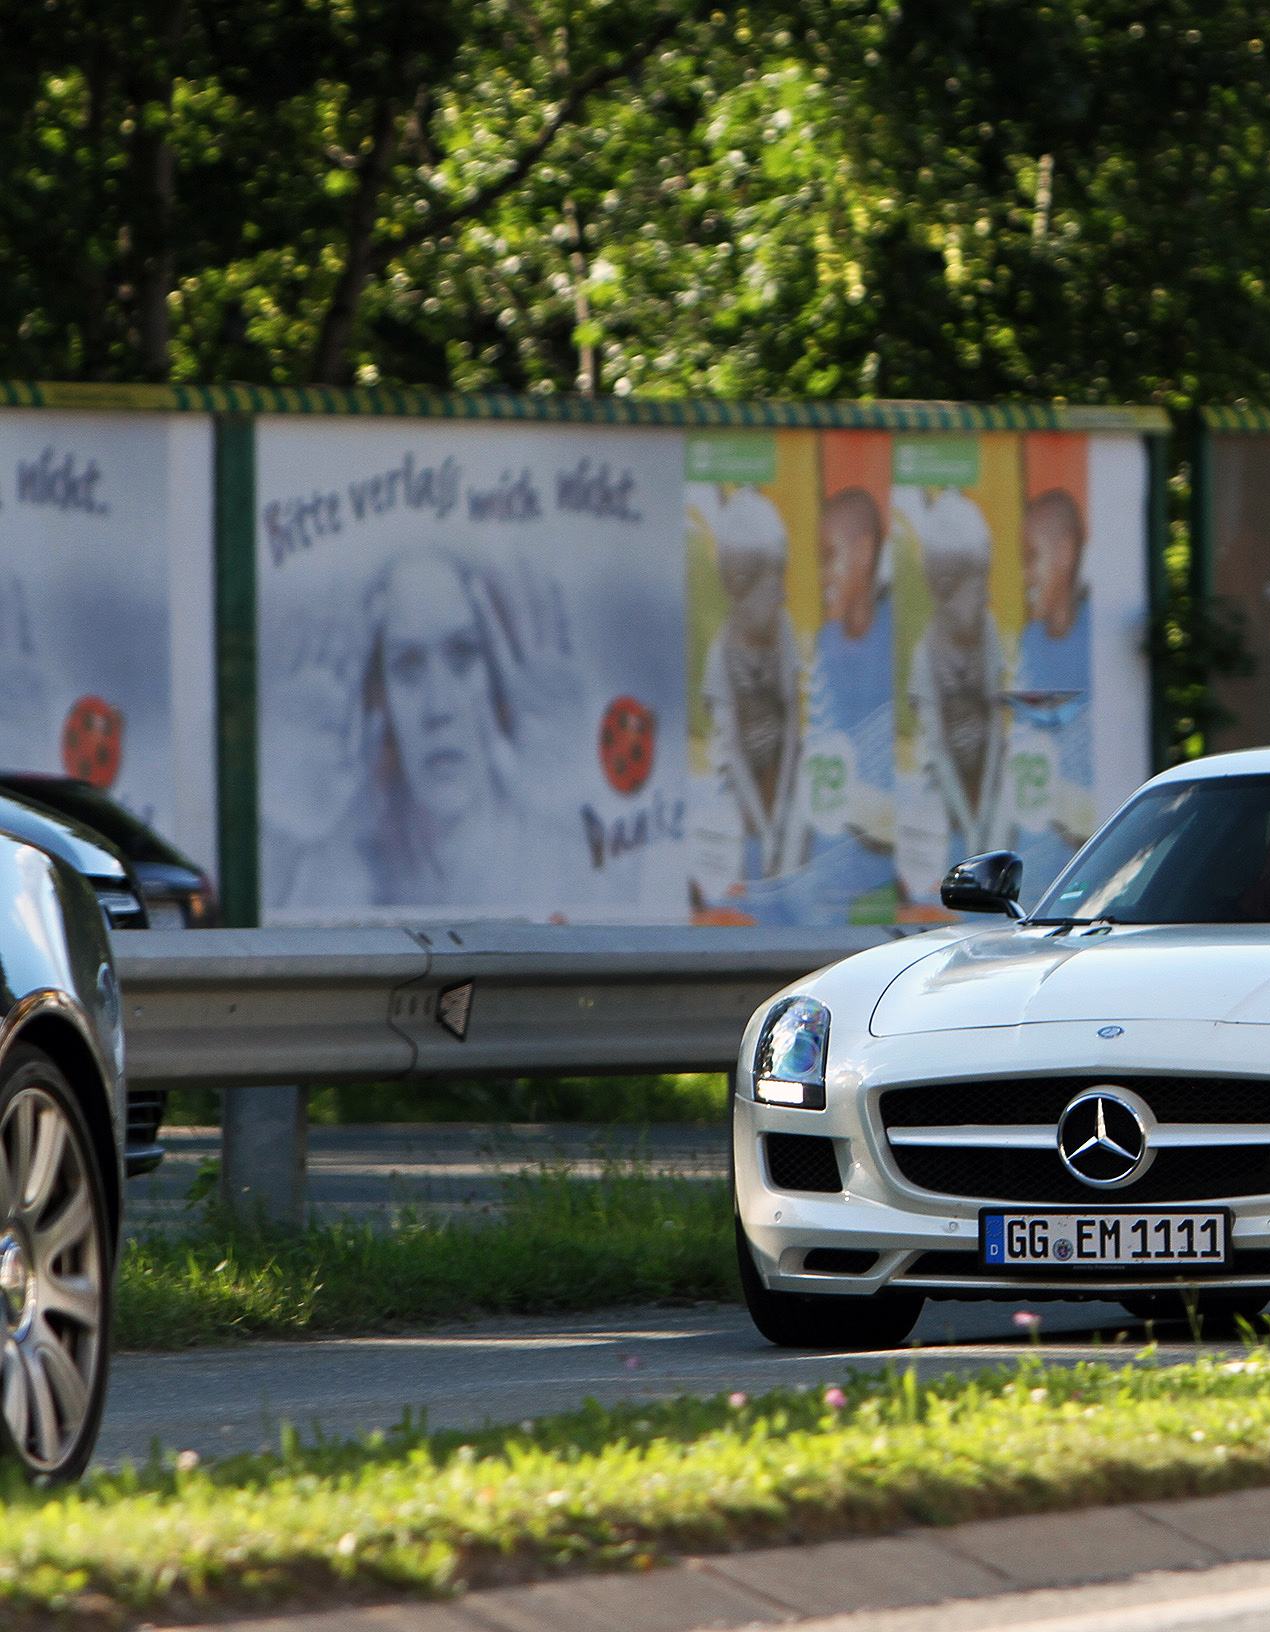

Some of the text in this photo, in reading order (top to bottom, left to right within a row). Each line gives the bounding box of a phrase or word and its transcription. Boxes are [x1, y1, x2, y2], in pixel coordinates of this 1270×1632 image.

[263, 496, 342, 567] Bitte
[990, 1244, 999, 1256] D
[1007, 1218, 1221, 1259] GG EM 1111
